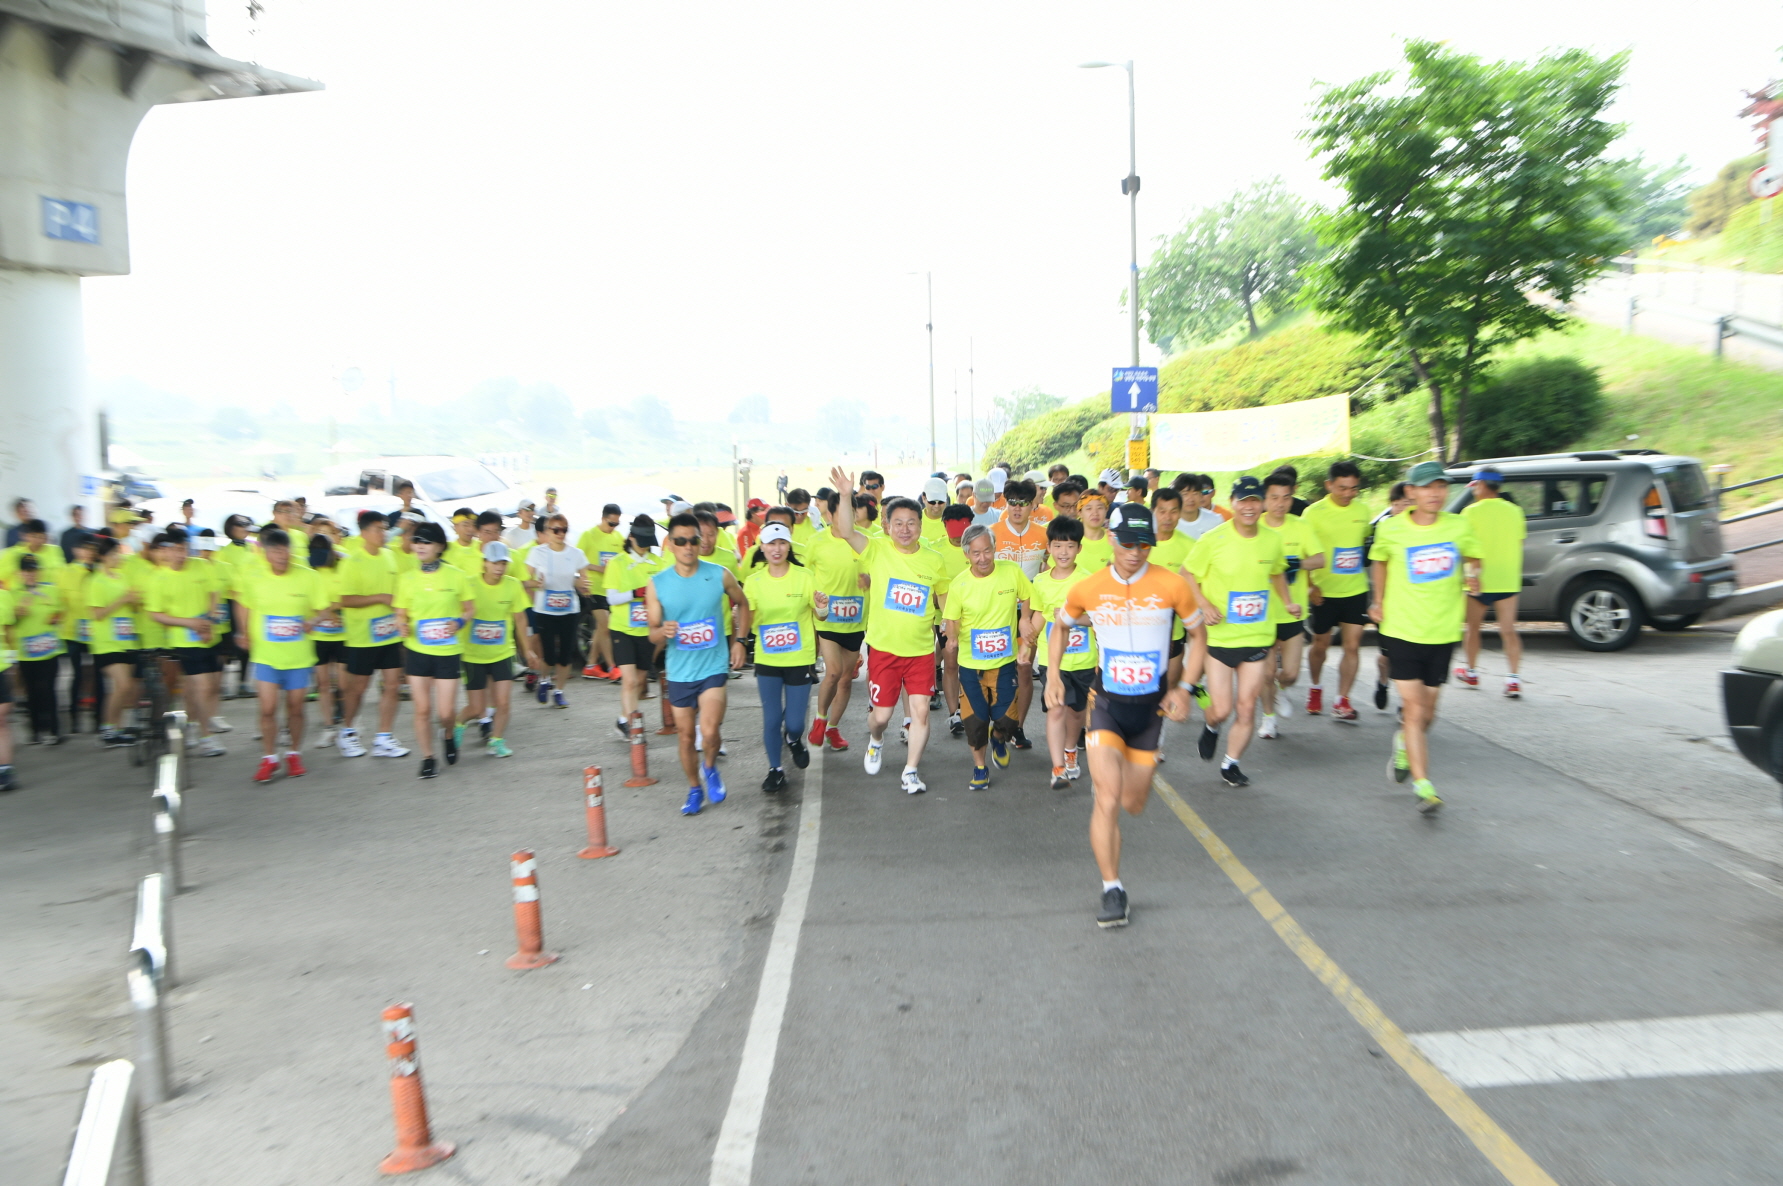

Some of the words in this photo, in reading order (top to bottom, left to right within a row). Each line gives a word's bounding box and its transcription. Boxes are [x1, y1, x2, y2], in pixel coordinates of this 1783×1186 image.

[893, 590, 922, 609] 101
[632, 610, 648, 622] 23
[833, 605, 858, 618] 110
[1235, 603, 1263, 617] 121
[1093, 612, 1123, 627] GNI
[679, 629, 714, 645] 260
[765, 632, 798, 648] 289
[976, 638, 1007, 653] 153
[1110, 666, 1154, 685] 135
